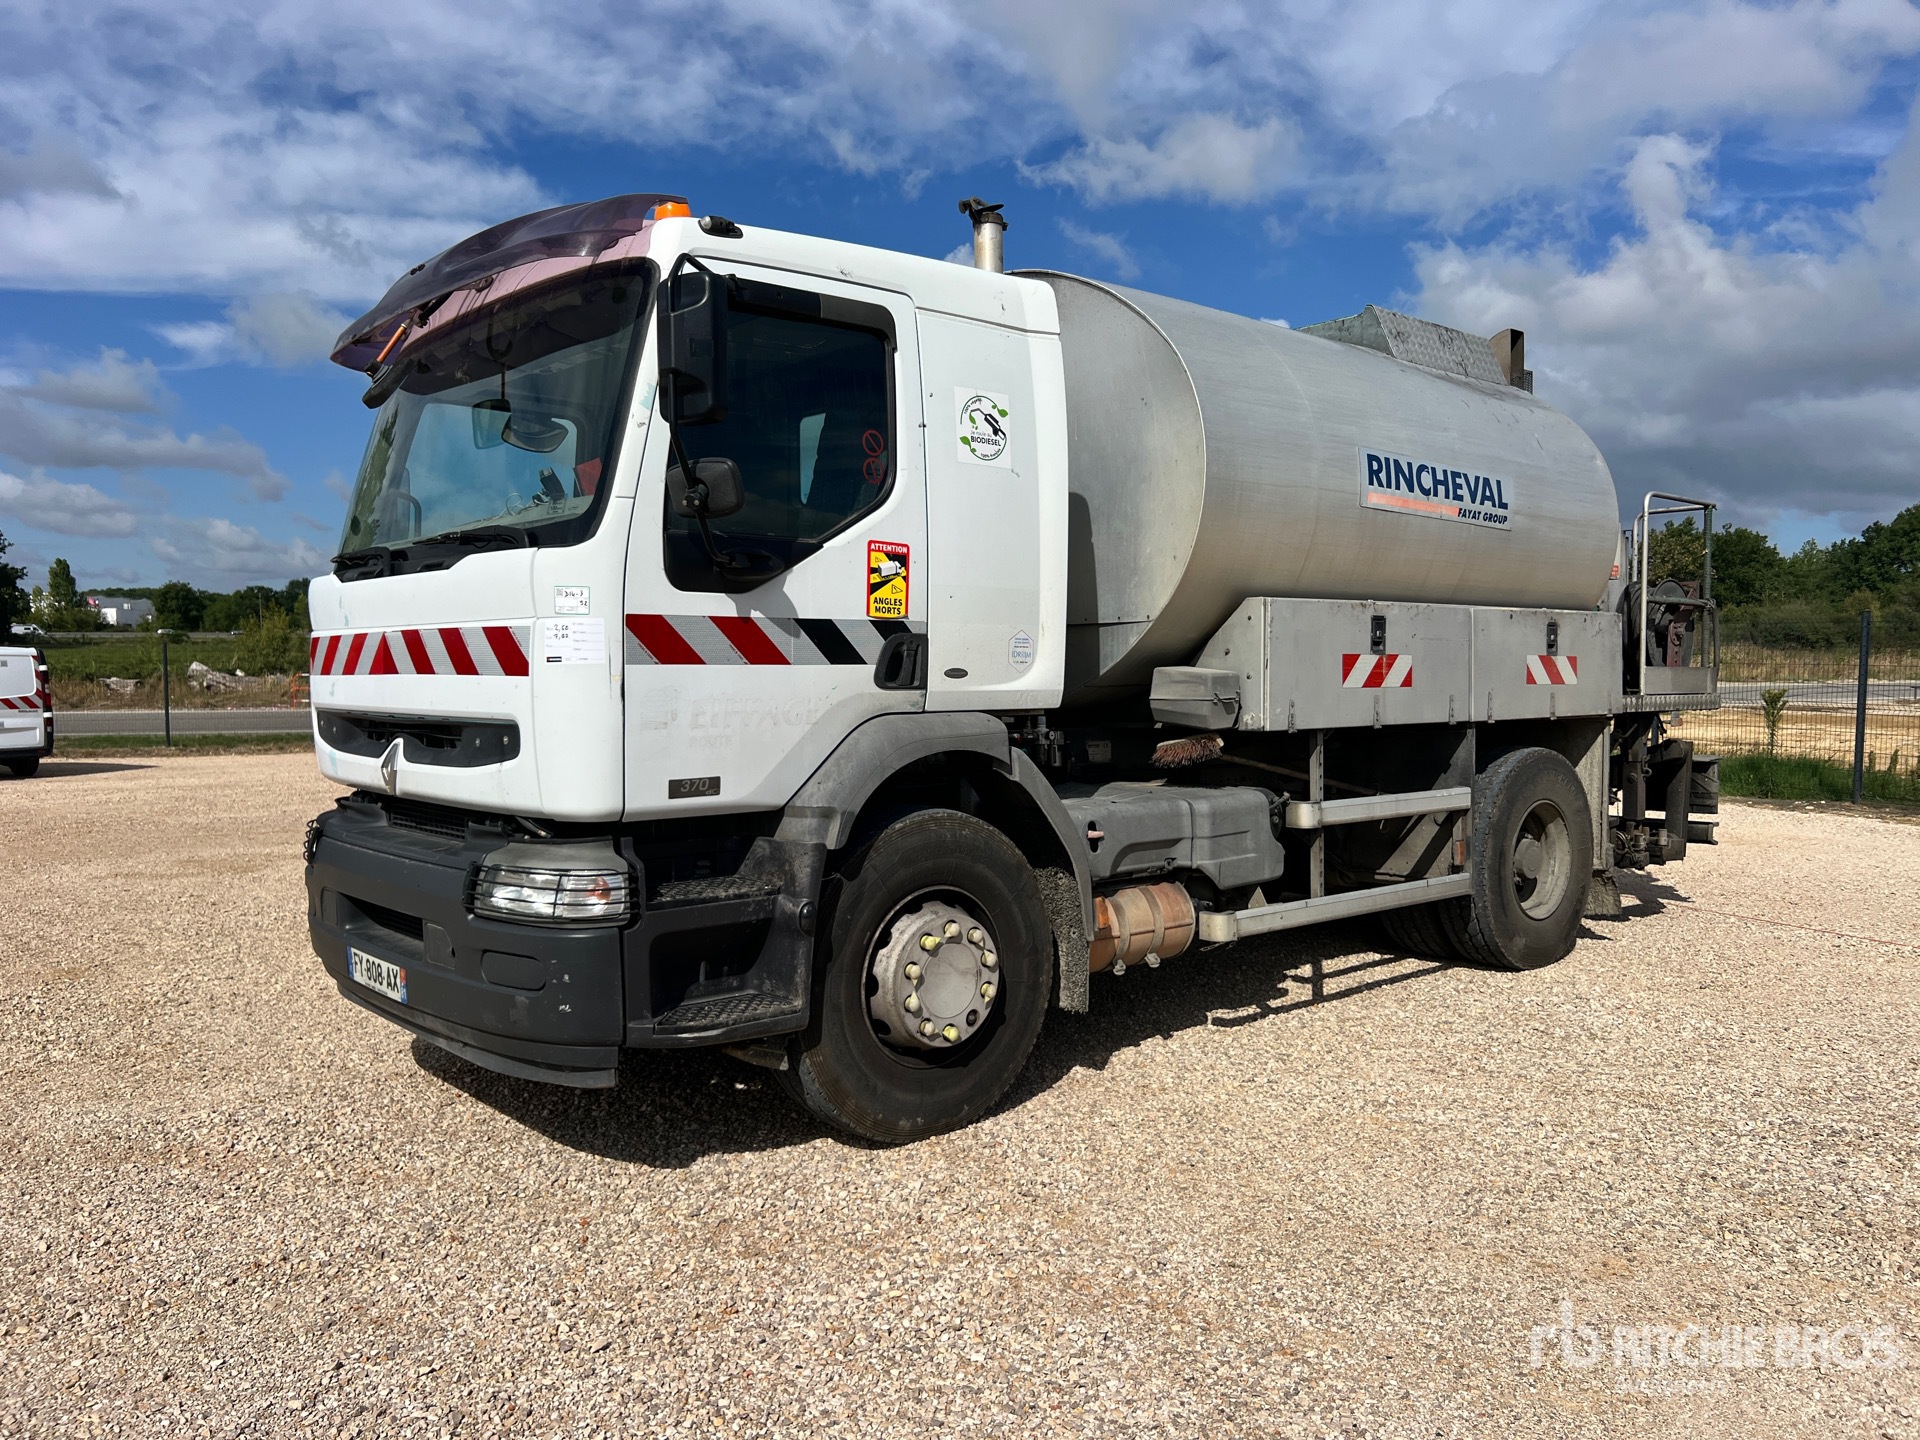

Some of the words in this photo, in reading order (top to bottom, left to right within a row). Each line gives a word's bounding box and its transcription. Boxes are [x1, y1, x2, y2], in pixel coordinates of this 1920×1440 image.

[970, 436, 1001, 446] BIODIESEL
[1366, 453, 1509, 510] RINCHEVAL
[1457, 507, 1482, 521] FAYAT
[1482, 512, 1508, 525] GROUP
[870, 543, 908, 553] ATTENTION
[873, 597, 903, 606] ANGLES
[874, 606, 902, 615] MORTS
[680, 778, 710, 793] 370
